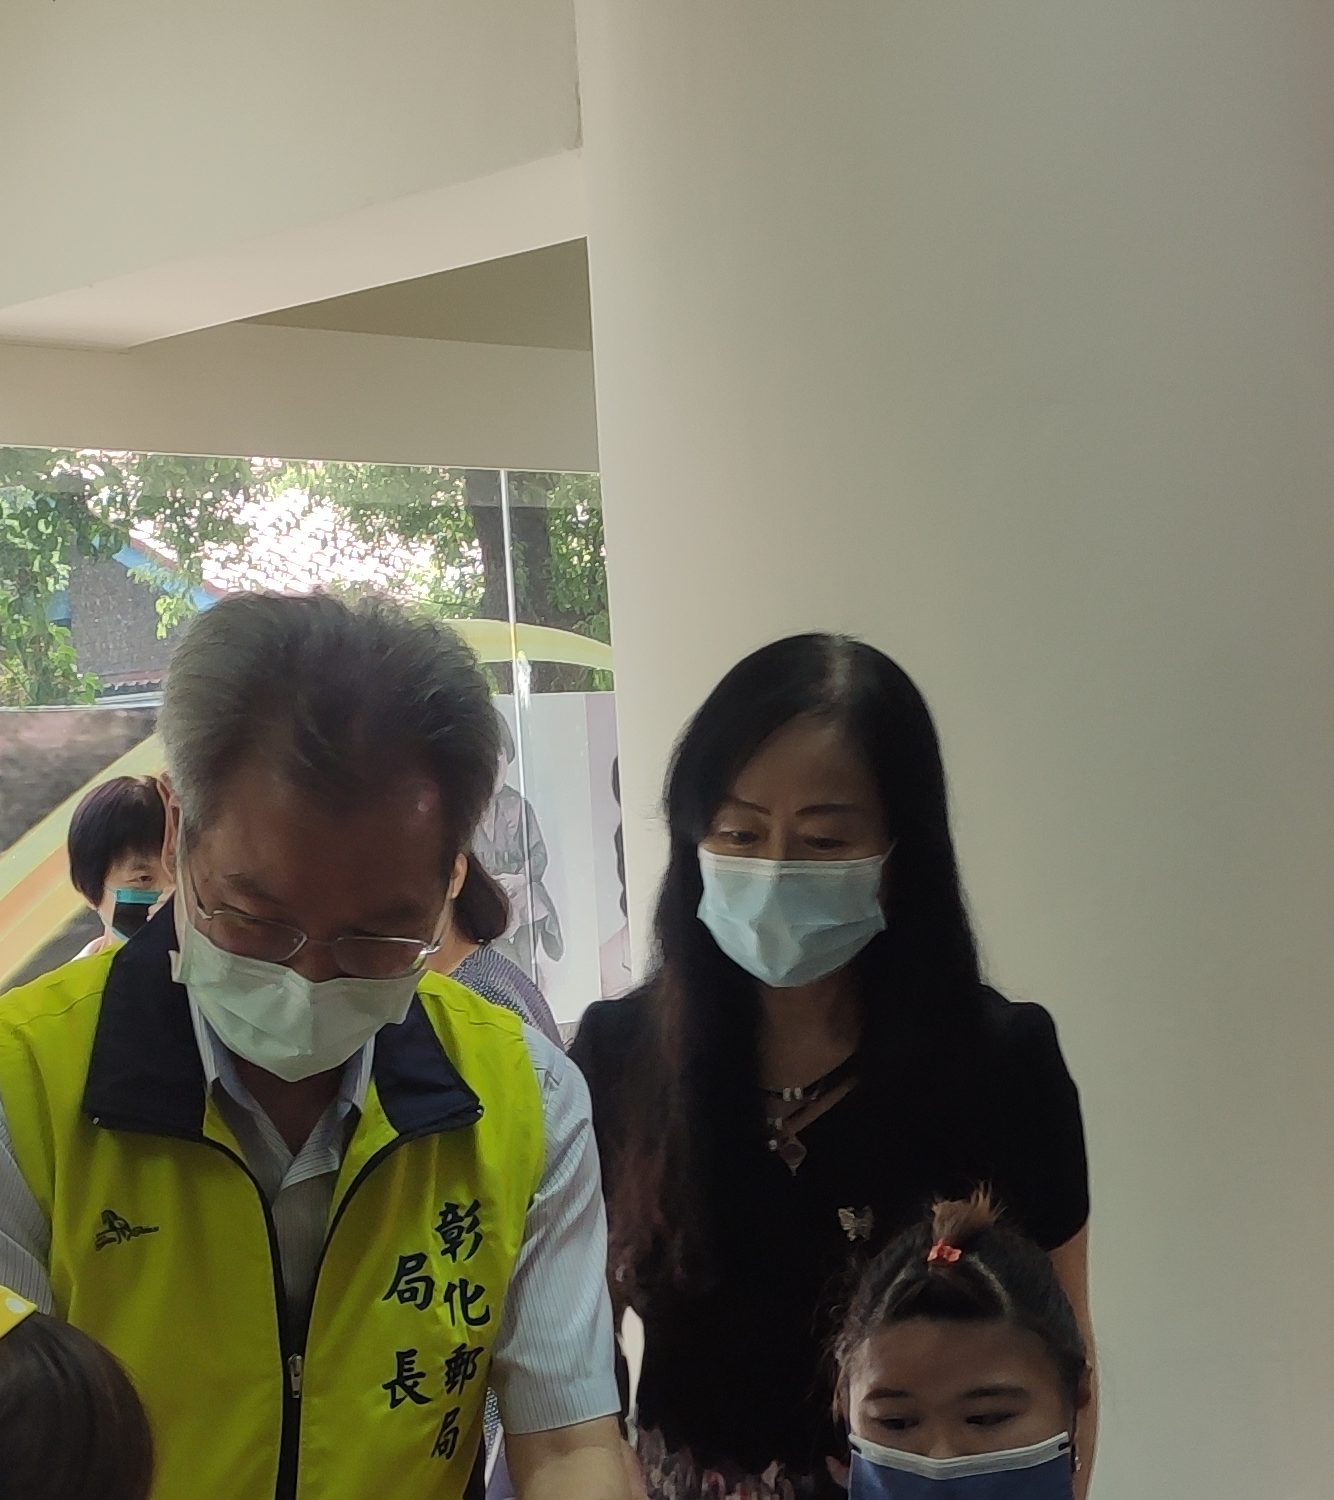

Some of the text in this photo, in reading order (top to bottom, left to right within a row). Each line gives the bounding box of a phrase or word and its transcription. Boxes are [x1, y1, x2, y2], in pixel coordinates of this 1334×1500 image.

[381, 1252, 434, 1410] 局長
[431, 1200, 491, 1461] 彰化郵局
